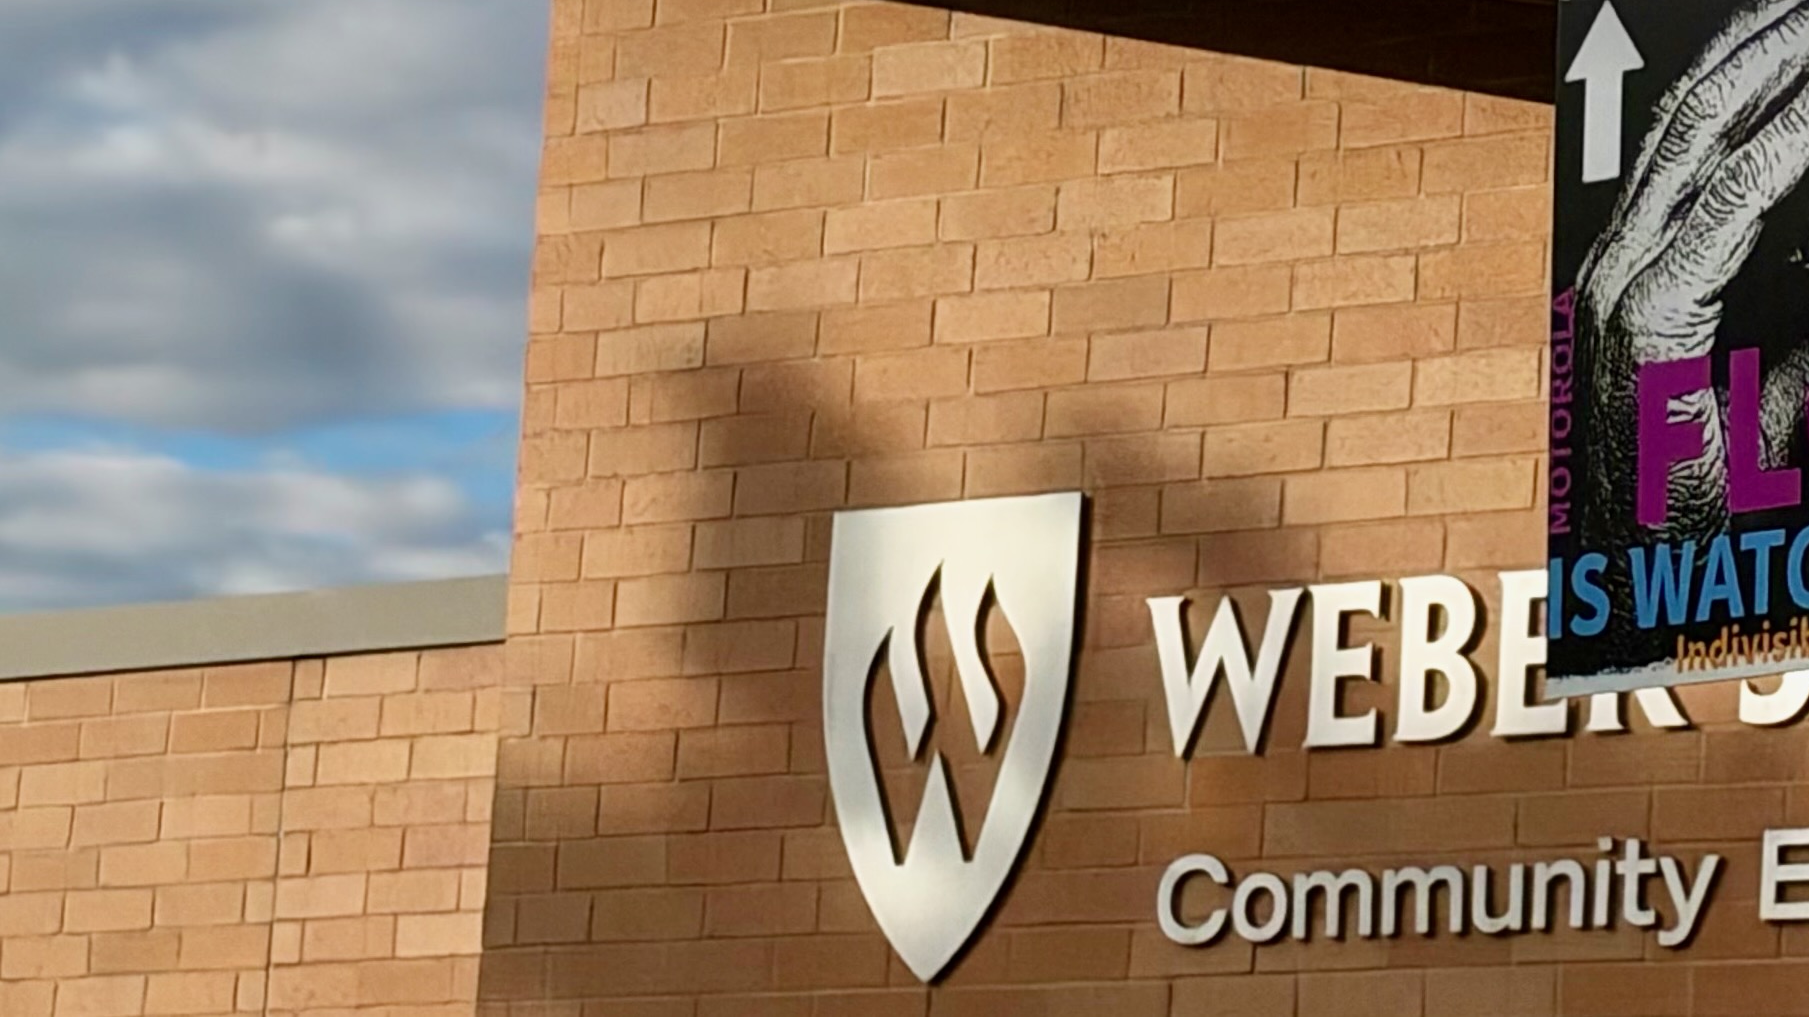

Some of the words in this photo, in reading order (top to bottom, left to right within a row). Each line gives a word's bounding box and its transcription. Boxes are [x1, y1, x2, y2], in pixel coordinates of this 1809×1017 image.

[1550, 286, 1576, 534] MOTOROLA
[1548, 553, 1610, 640] IS
[1157, 836, 1720, 949] Community
